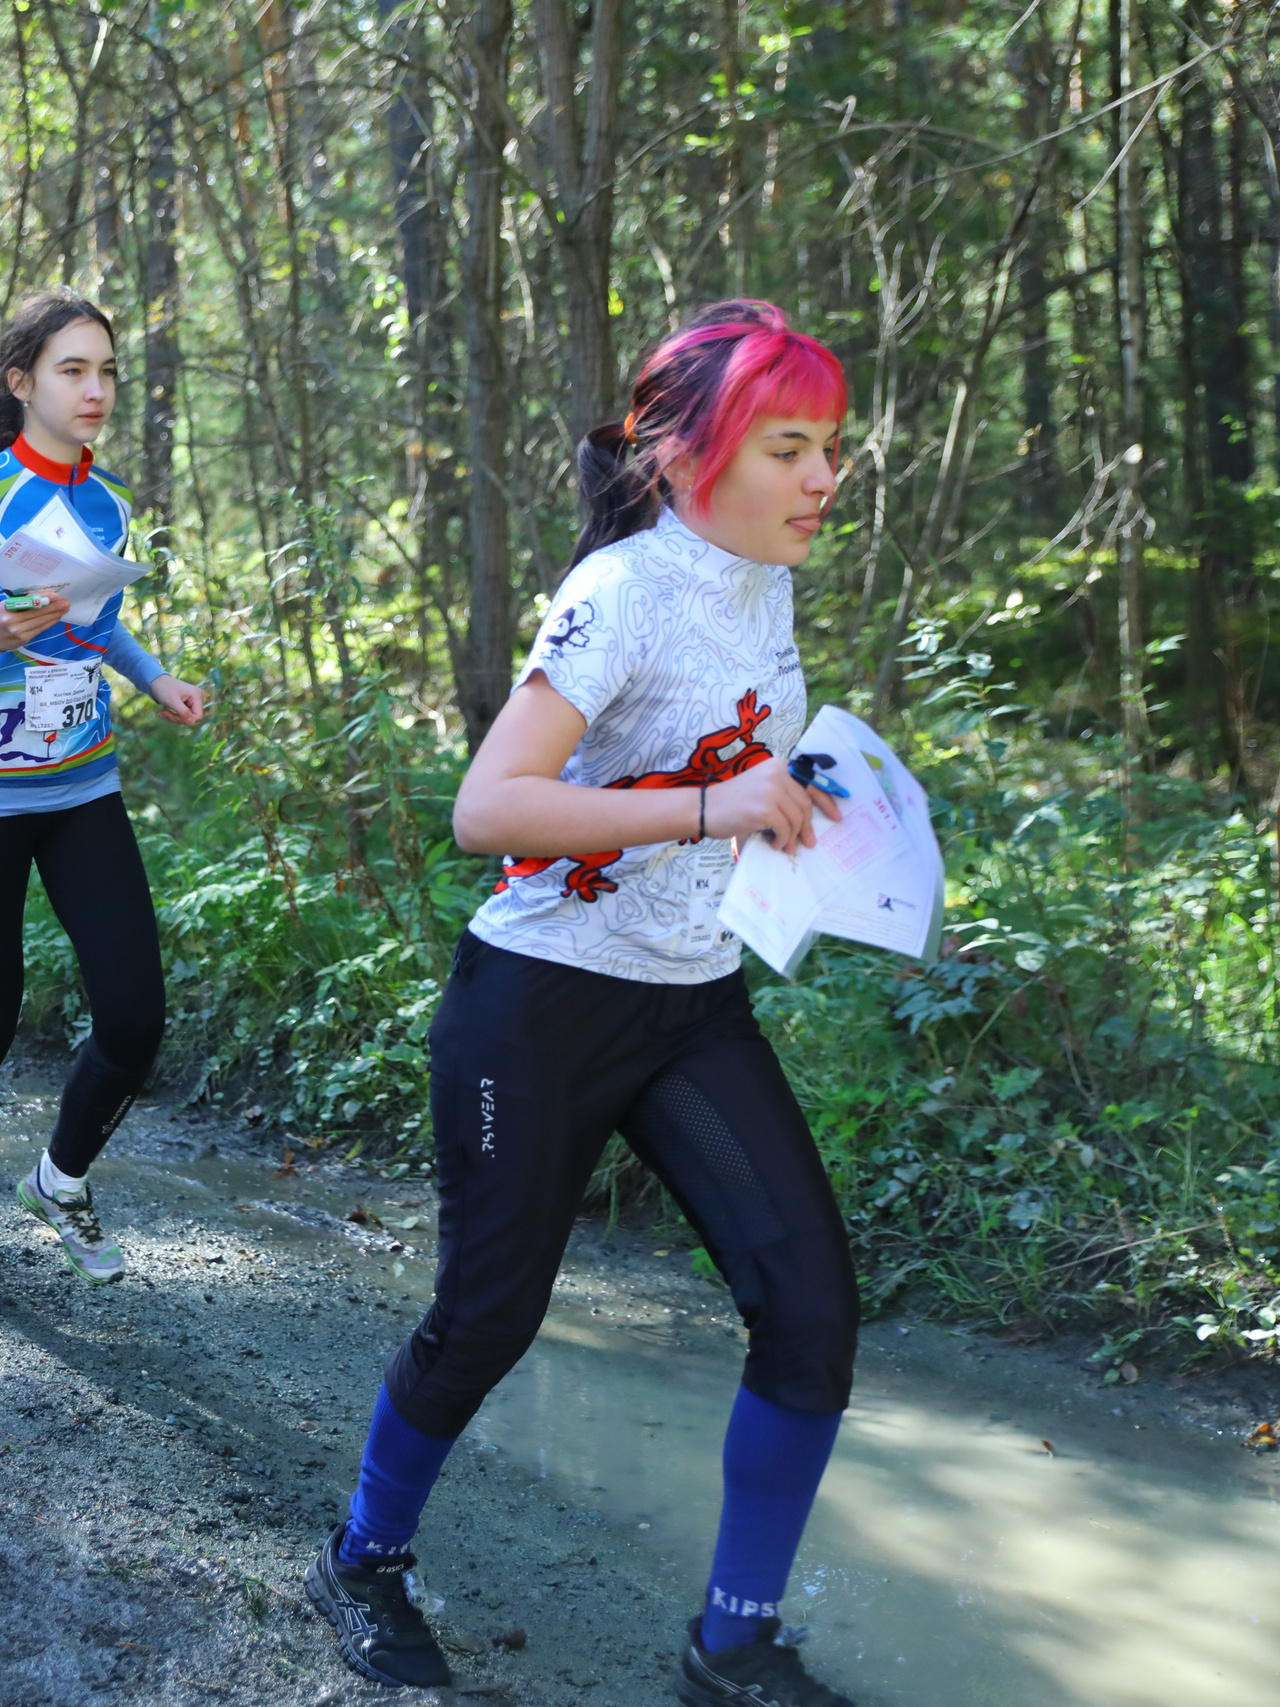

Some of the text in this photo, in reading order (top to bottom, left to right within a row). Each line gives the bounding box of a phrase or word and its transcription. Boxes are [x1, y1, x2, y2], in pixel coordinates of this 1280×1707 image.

[4, 541, 23, 559] 370.1
[62, 698, 94, 729] 370
[712, 1586, 780, 1617] KIPS
